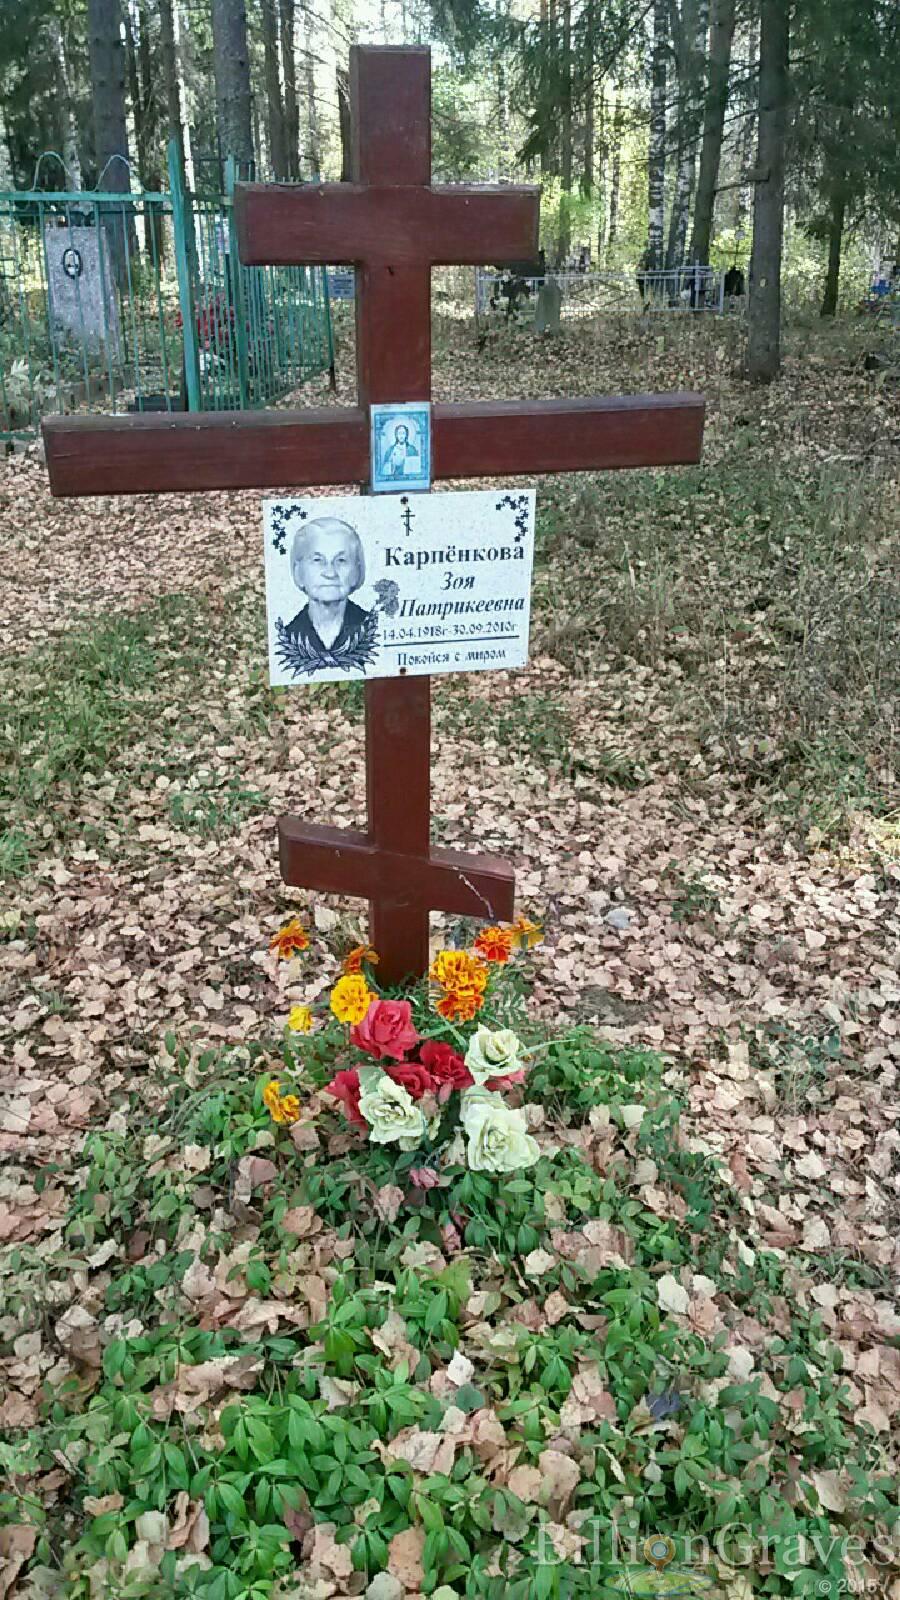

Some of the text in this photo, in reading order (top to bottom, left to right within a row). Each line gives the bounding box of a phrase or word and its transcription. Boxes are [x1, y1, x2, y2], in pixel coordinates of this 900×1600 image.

[385, 545, 525, 570] Карпёнкова
[440, 571, 475, 591] Зоя
[400, 597, 525, 620] Патрикеевна
[397, 649, 506, 666] Покойся с миром
